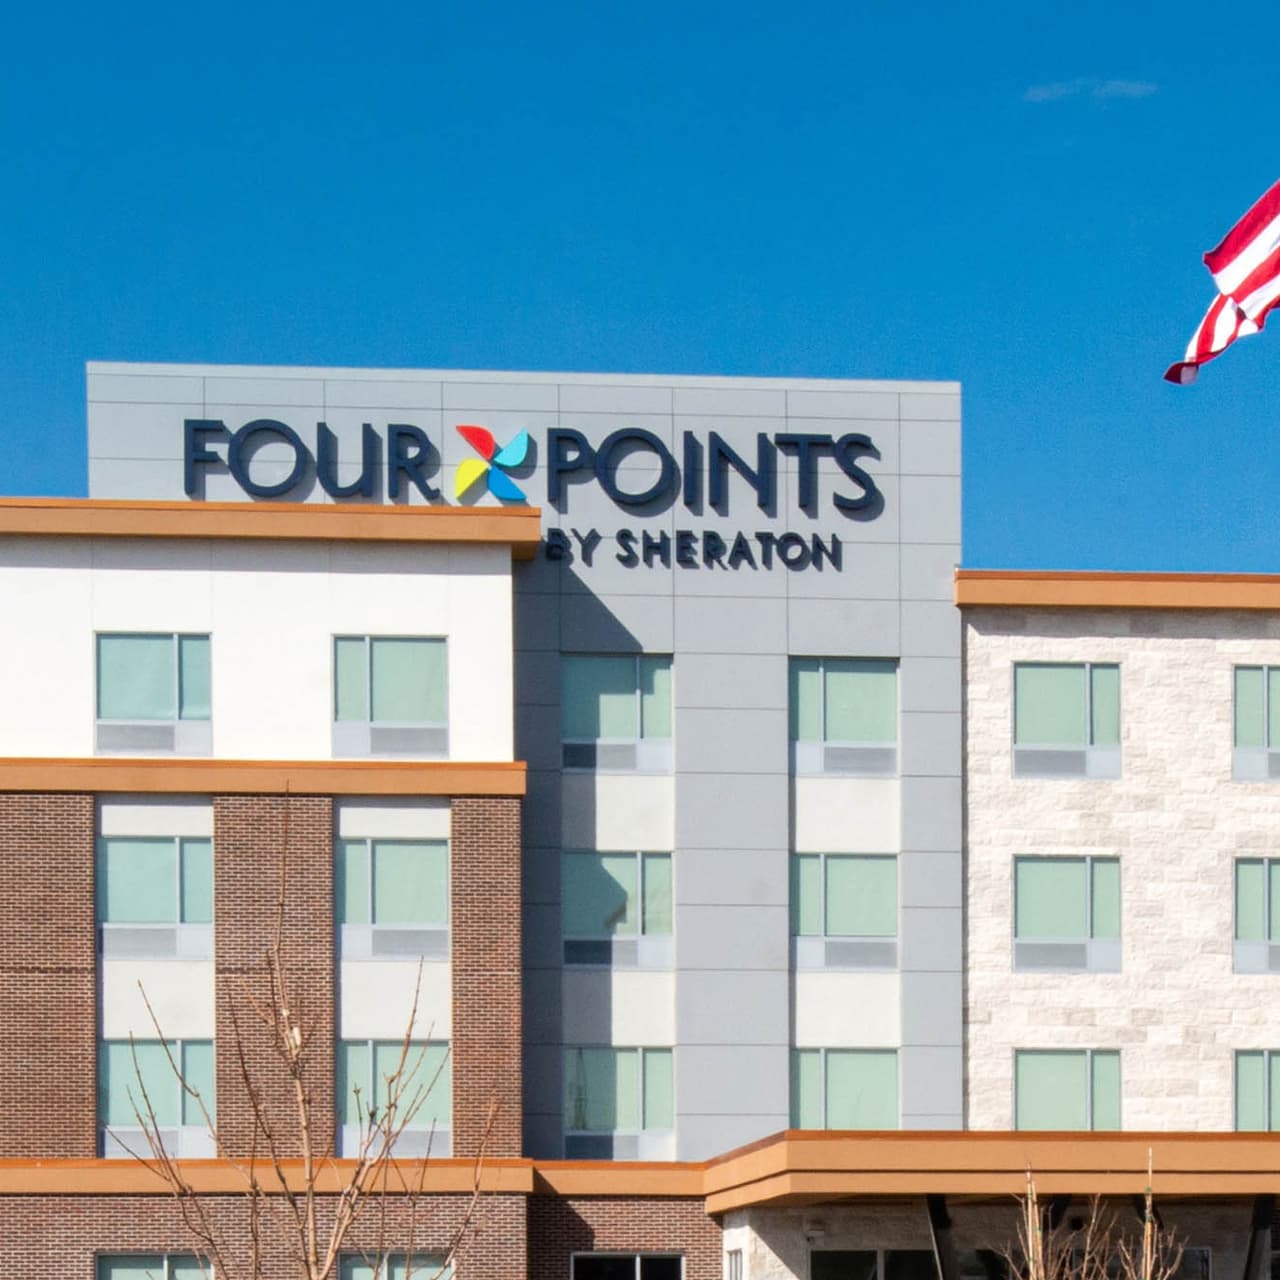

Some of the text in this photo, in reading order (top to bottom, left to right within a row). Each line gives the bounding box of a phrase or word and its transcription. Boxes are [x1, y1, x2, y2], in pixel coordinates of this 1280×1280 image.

[184, 419, 879, 511] FOUR POINTS
[546, 528, 842, 571] BY SHERATON
